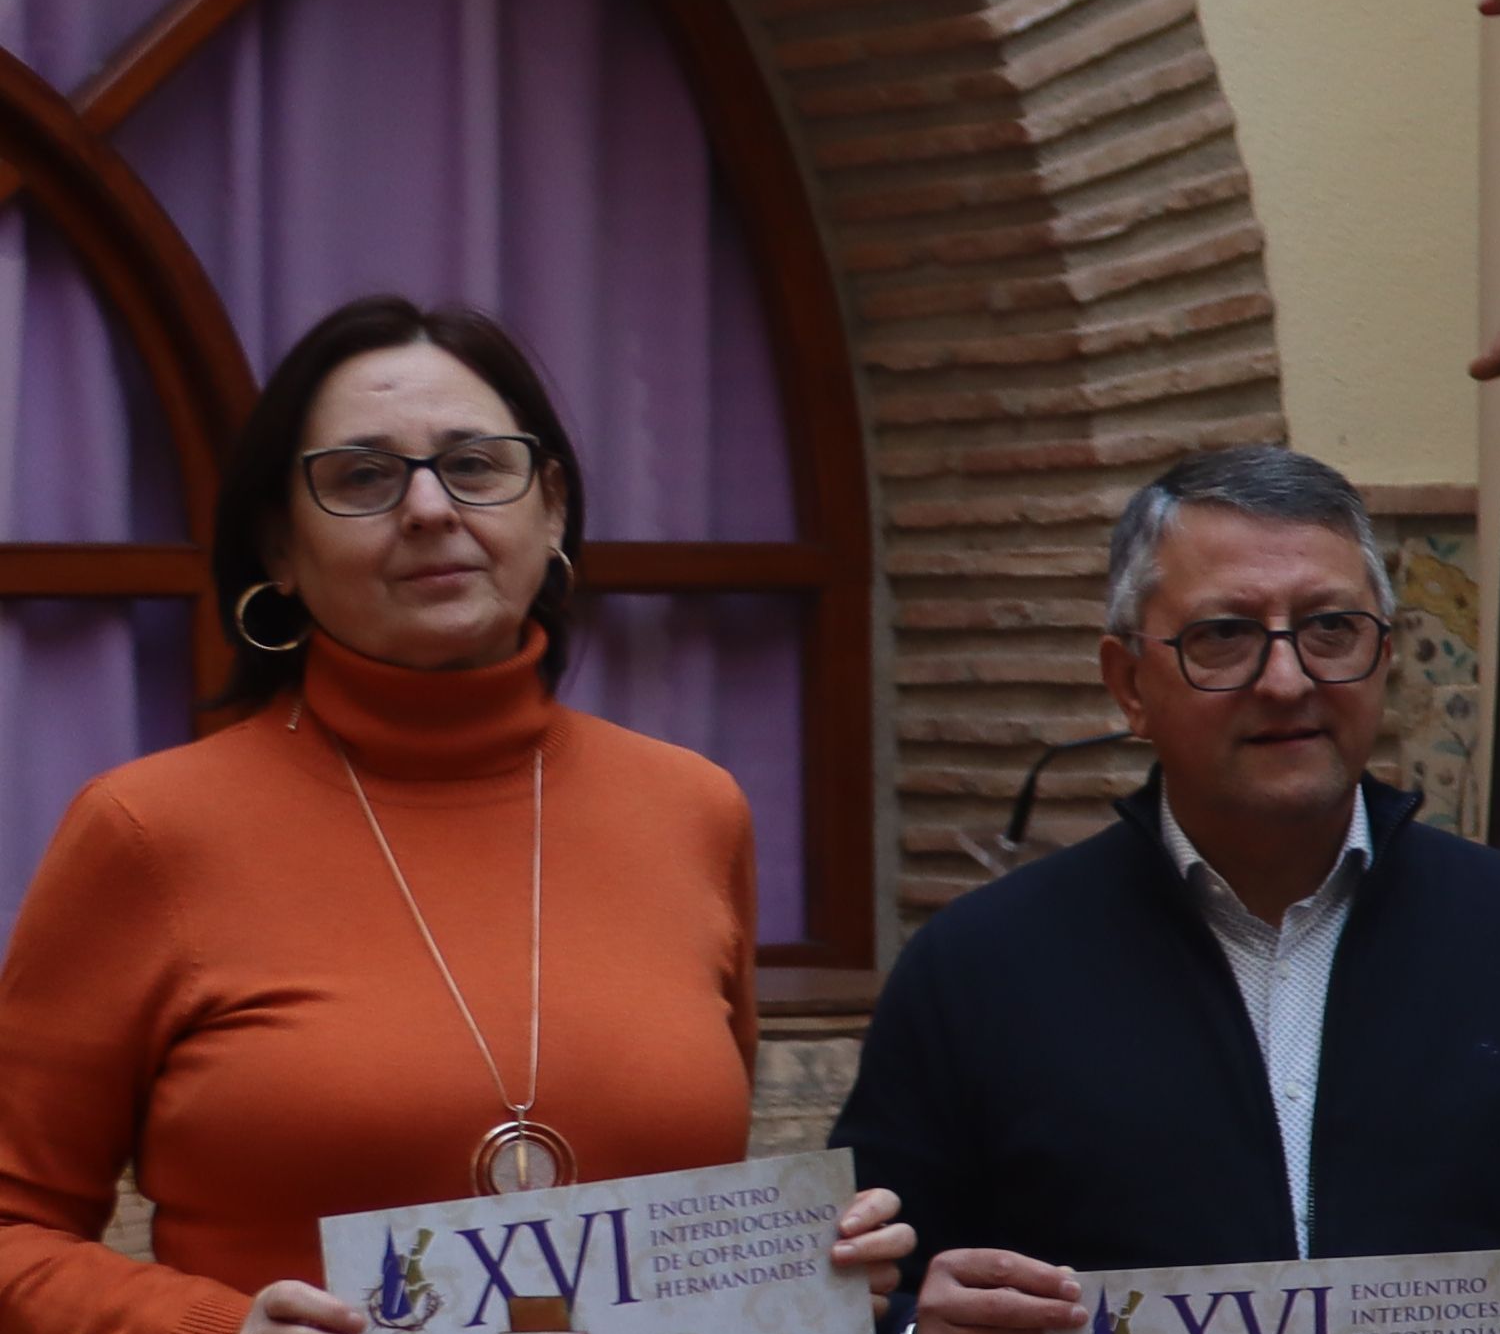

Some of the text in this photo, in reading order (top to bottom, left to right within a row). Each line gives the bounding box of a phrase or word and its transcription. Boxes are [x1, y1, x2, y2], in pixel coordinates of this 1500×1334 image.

[648, 1188, 779, 1219] ENCUENTRO
[650, 1204, 837, 1245] INTERDIOCESANO
[456, 1209, 641, 1326] XVI
[655, 1232, 820, 1273] DE COFRADÍAS Y
[656, 1260, 817, 1298] HERMANDADES
[1351, 1278, 1485, 1299] ENCUENTRO
